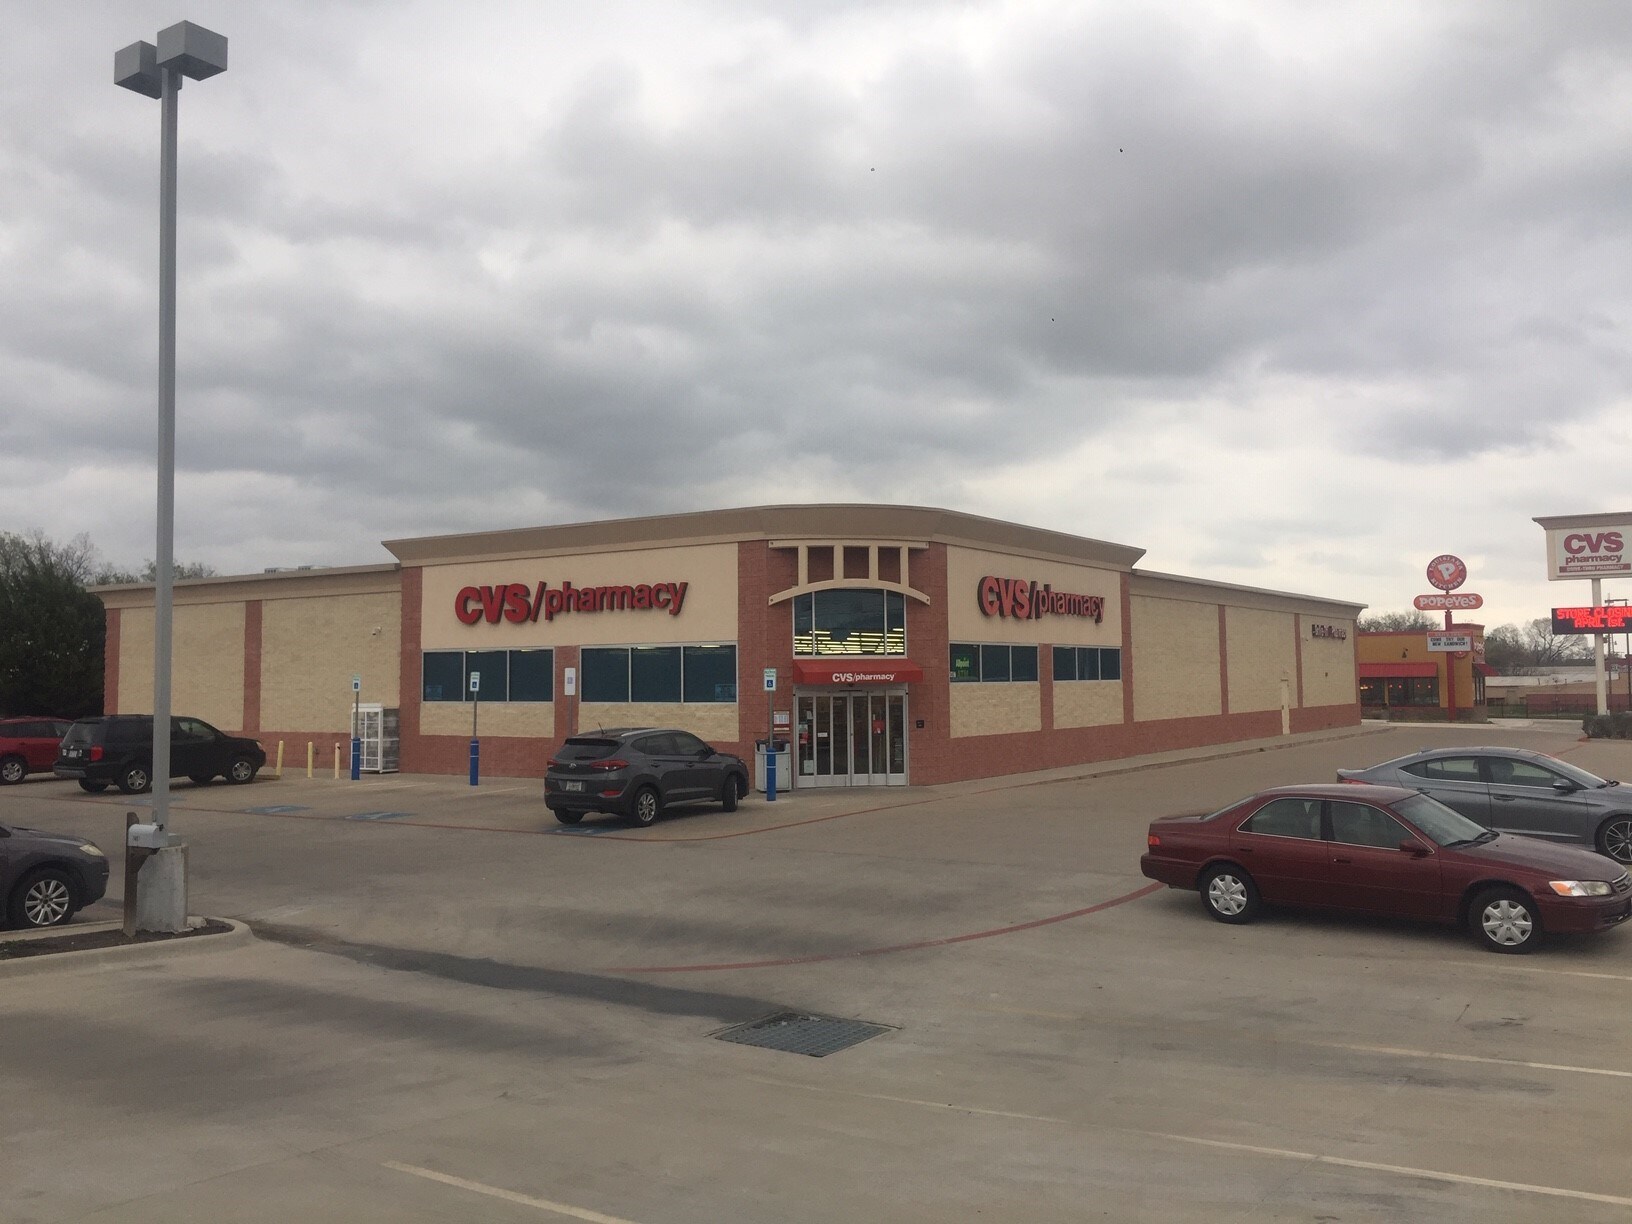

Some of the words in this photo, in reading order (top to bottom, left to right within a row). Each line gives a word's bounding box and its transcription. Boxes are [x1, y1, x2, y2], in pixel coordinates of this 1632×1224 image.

[1563, 531, 1624, 554] CVS
[1565, 554, 1623, 565] pharmacy
[454, 581, 688, 625] CVS/pharmacy
[977, 575, 1105, 624] CVS/pharmacy
[1556, 608, 1591, 619] STORE
[1594, 607, 1632, 618] CLOSIN
[1574, 616, 1605, 628] APRIL
[832, 673, 895, 682] CVS/pharmacy
